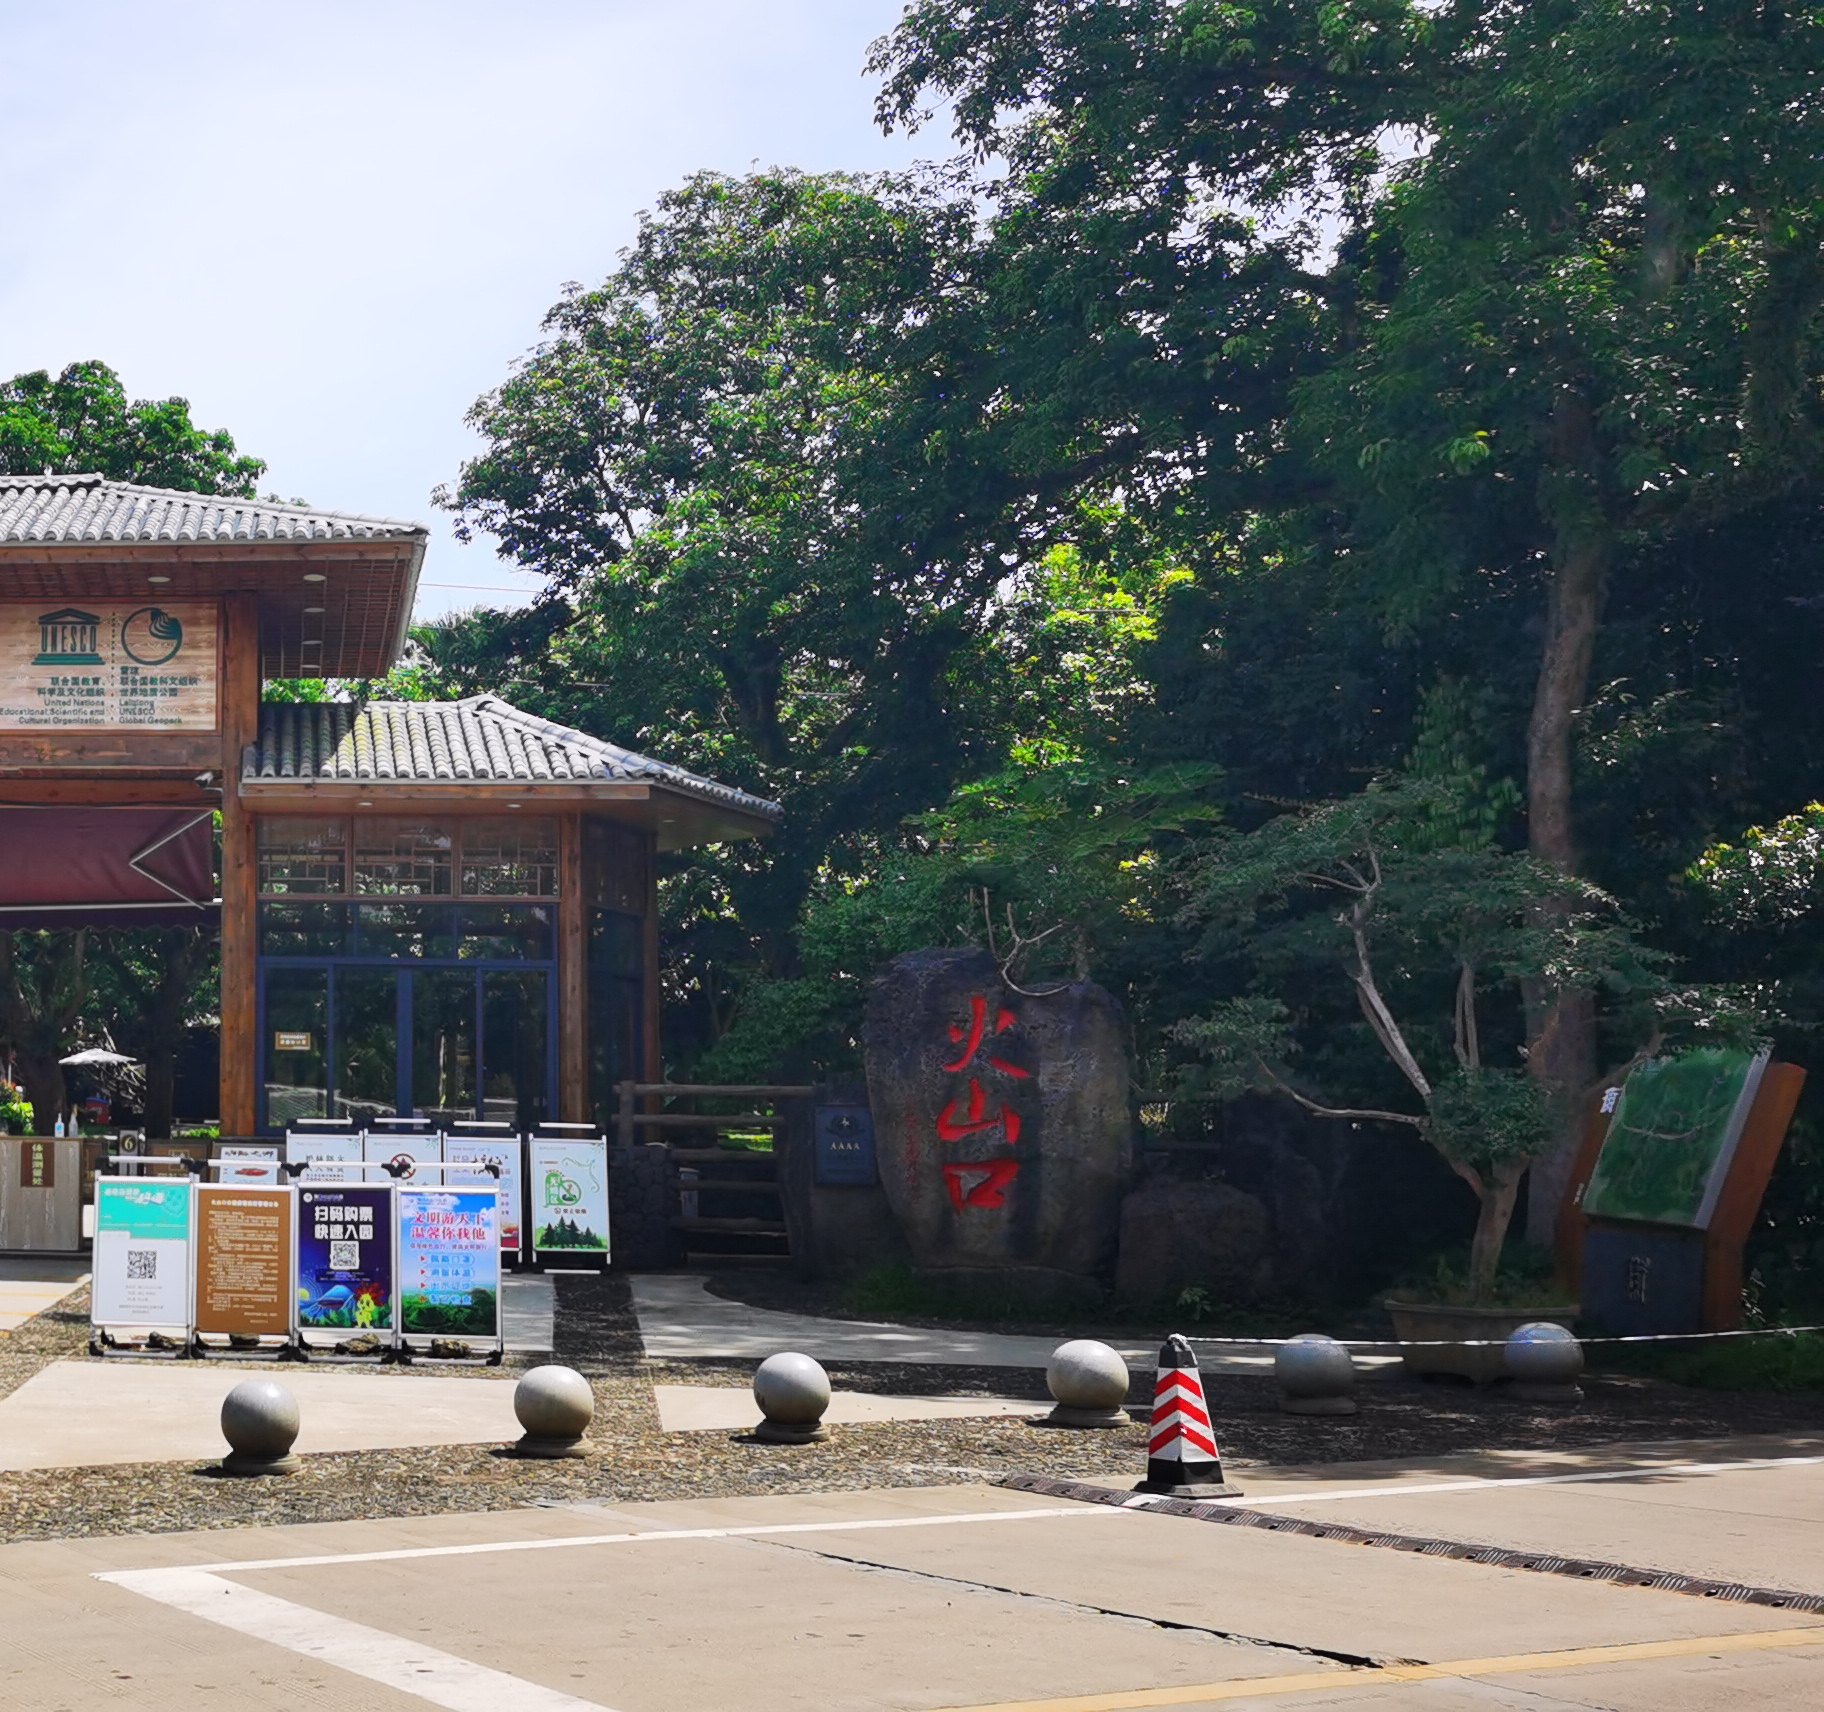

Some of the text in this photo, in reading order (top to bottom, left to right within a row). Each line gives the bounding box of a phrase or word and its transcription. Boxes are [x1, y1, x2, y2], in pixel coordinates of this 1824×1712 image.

[41, 625, 97, 653] UNESCO
[936, 995, 1029, 1215] 火山口
[314, 1206, 373, 1222] 扫码购票
[414, 1211, 486, 1225] 文明游天下
[314, 1224, 373, 1240] 快速入园
[411, 1226, 486, 1241] 温馨你我他
